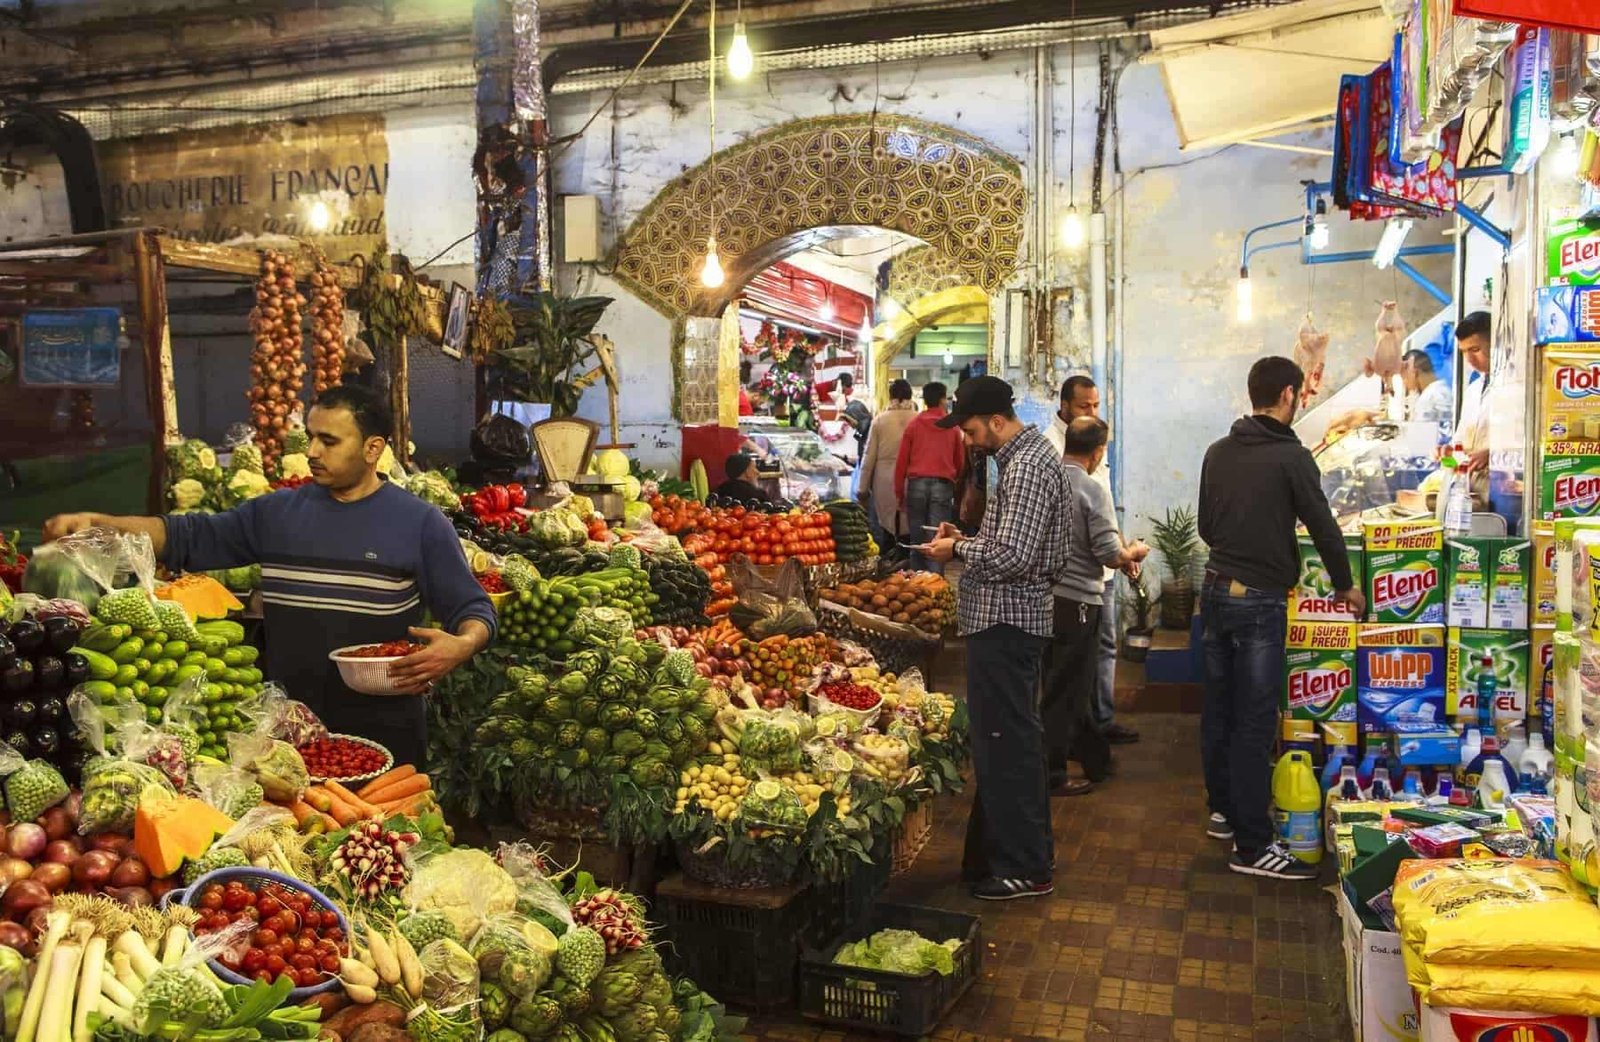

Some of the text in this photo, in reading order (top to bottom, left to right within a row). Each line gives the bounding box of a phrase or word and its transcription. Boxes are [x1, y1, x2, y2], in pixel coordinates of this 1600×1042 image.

[110, 174, 249, 213] BOUCHERIE
[1546, 442, 1575, 455] +35%
[1373, 526, 1391, 545] 80
[1395, 536, 1436, 549] PRECIO!
[1373, 567, 1438, 605] Elena
[1298, 598, 1358, 614] ARIEL
[1289, 625, 1307, 643] 80
[1311, 636, 1351, 648] PRECIO!
[1448, 647, 1458, 694] XXL PACK
[1288, 668, 1352, 702] Elena
[1371, 679, 1426, 688] EXPRESS
[1459, 694, 1522, 711] AEL
